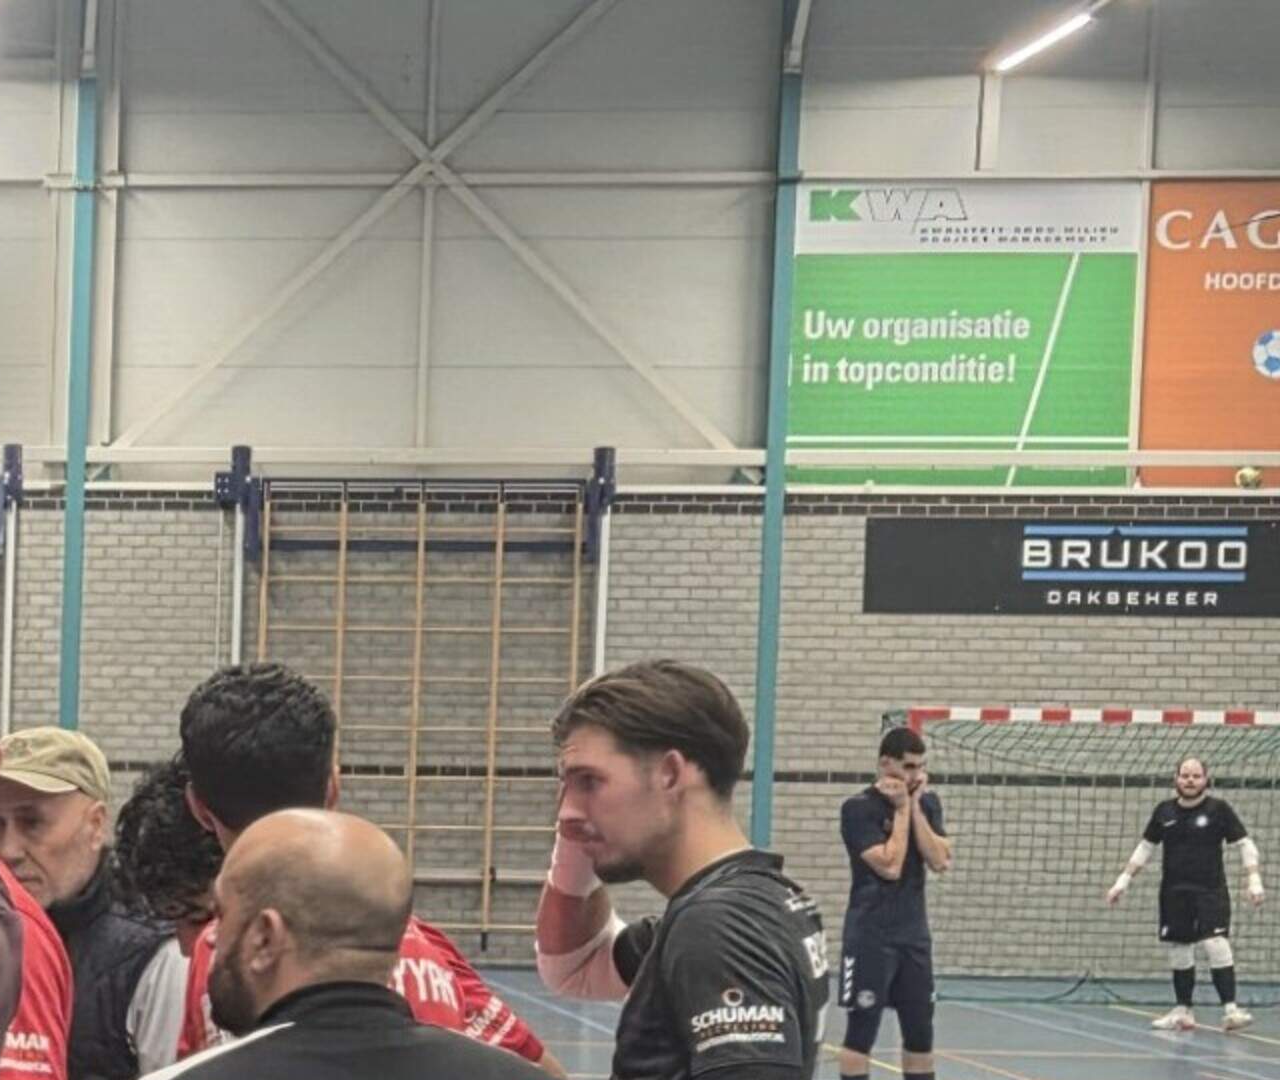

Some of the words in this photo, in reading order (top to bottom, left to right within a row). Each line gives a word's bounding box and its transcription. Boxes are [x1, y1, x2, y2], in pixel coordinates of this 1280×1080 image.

[809, 189, 968, 222] KWA
[803, 310, 854, 340] Uw
[862, 310, 1031, 345] organisatie
[802, 355, 829, 383] in
[837, 353, 1016, 391] topconditie!
[1021, 540, 1248, 569] BRUKOO
[1046, 590, 1219, 606] DAKBEHEER
[691, 1005, 785, 1033] SCHUMAN
